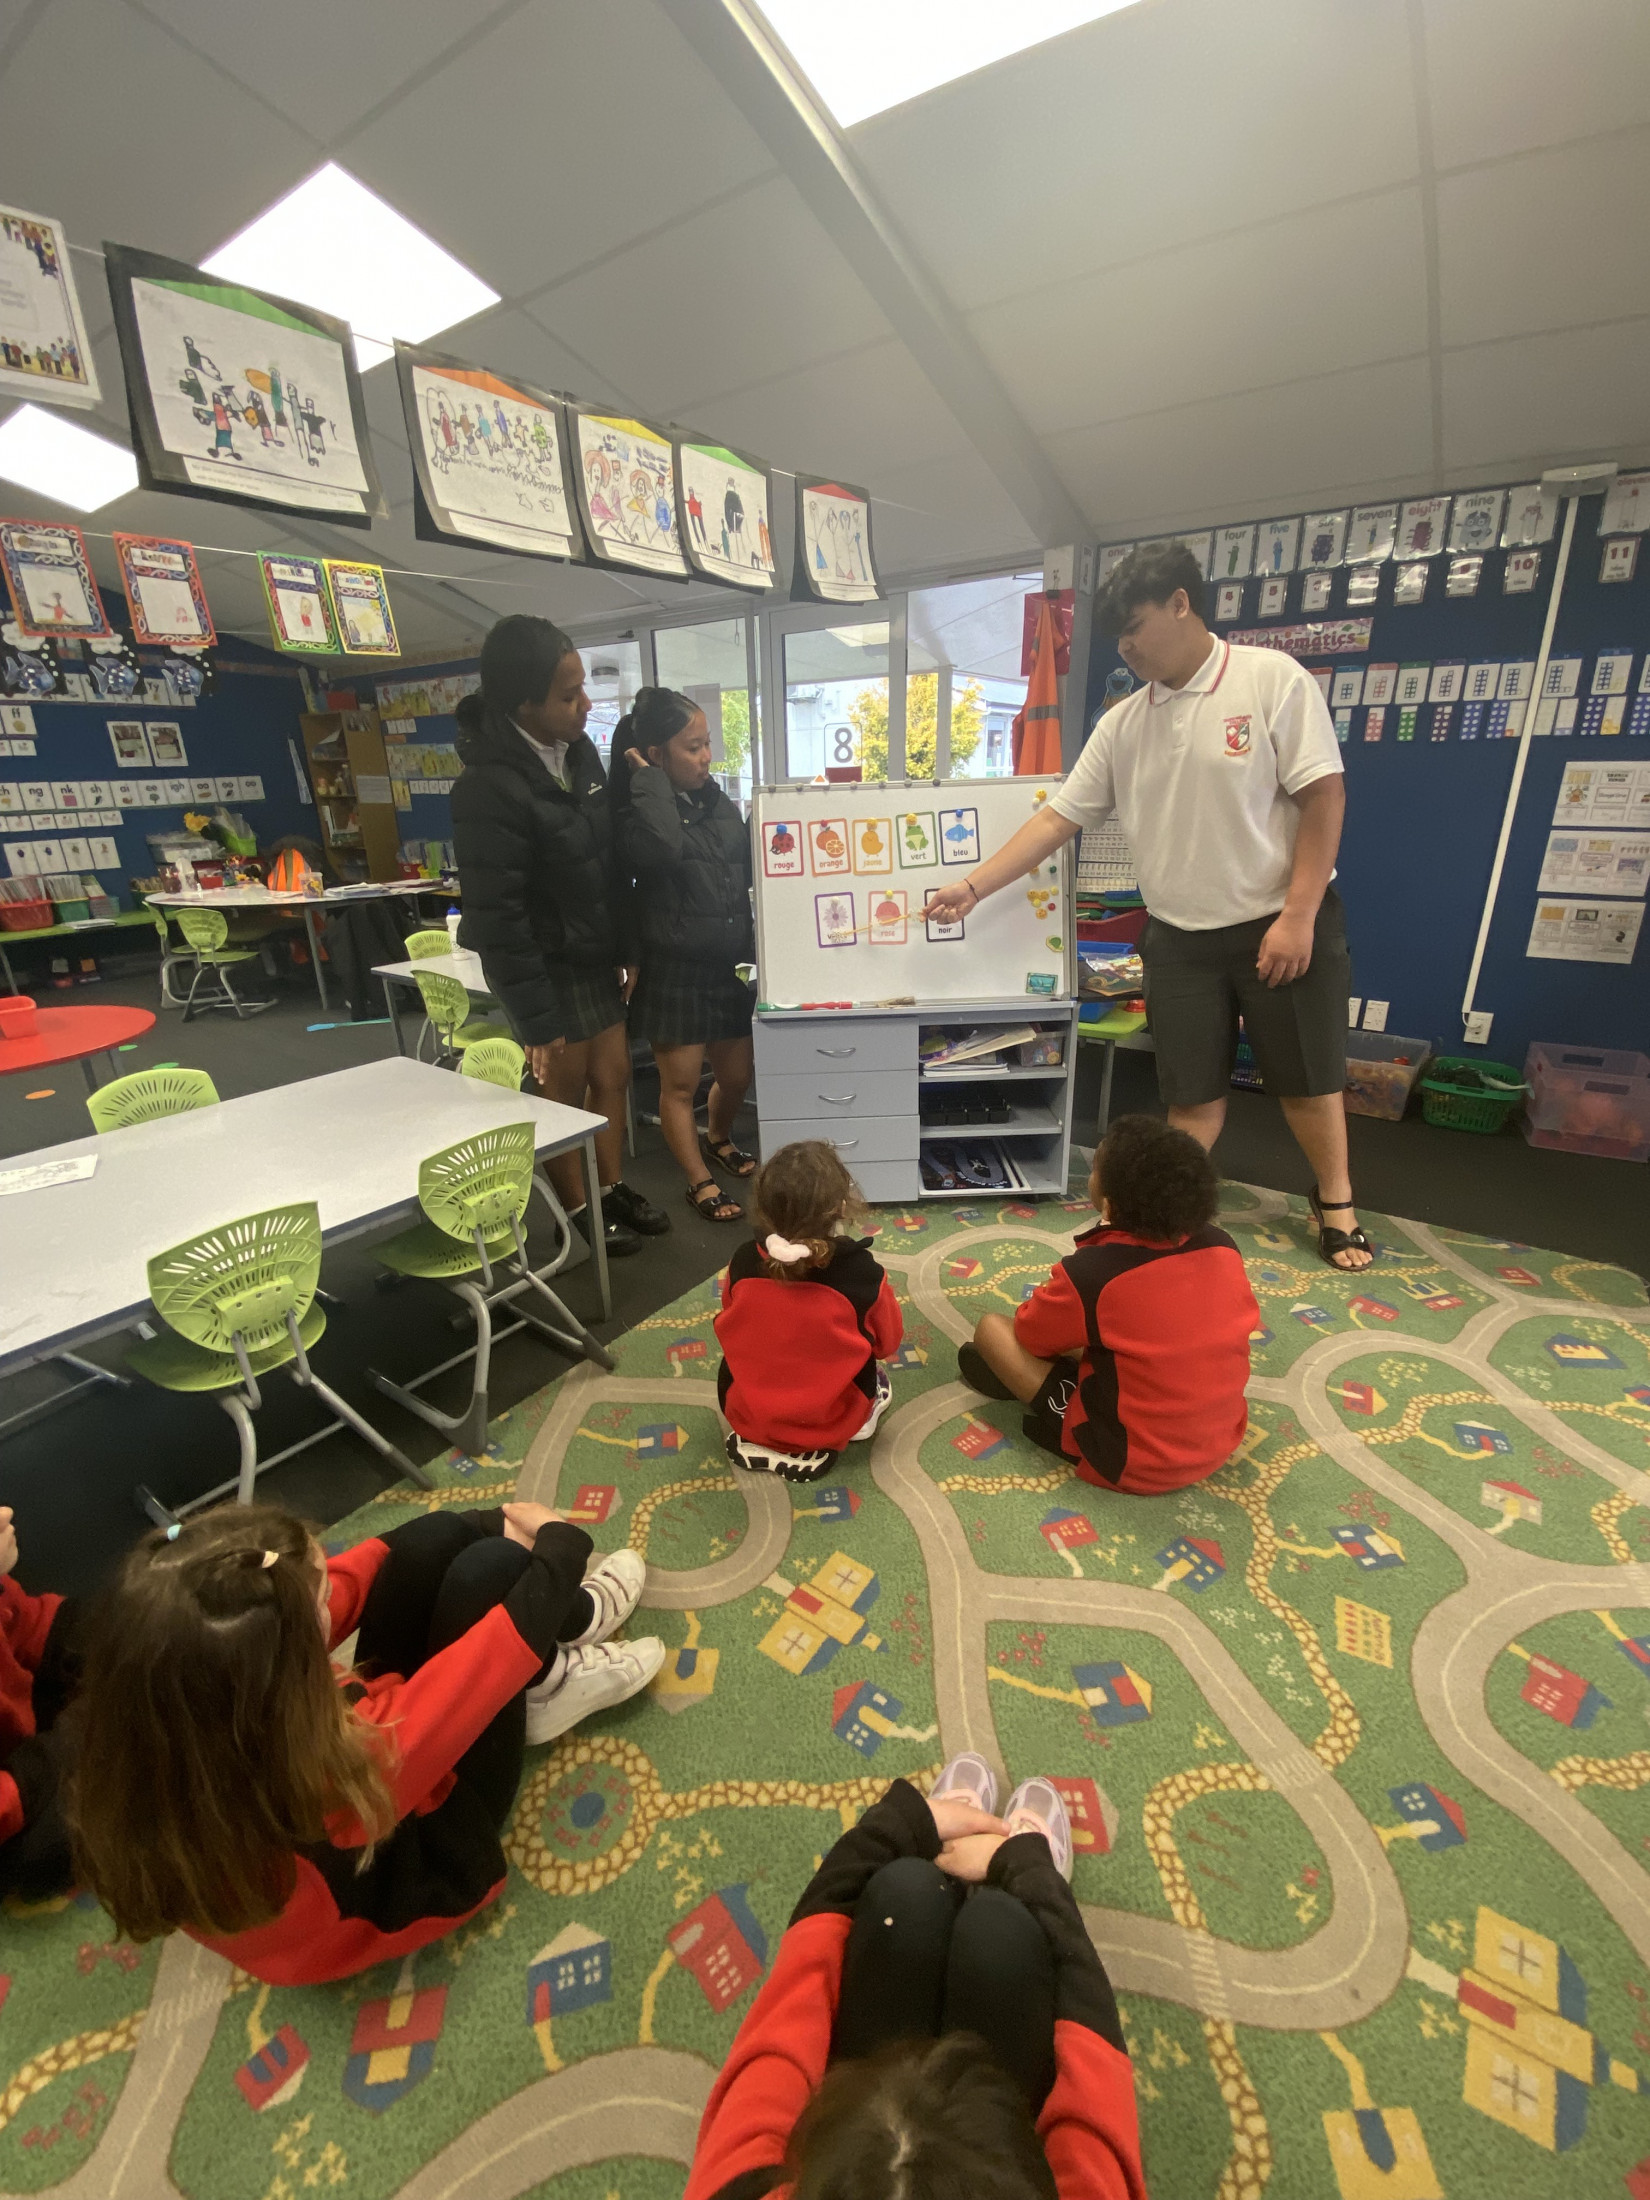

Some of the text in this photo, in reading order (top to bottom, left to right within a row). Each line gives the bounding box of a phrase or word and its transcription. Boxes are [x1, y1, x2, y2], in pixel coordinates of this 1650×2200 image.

[1465, 495, 1495, 507] nine
[1408, 502, 1442, 516] eight
[1357, 508, 1393, 522] seven
[1269, 523, 1290, 535] five
[1224, 529, 1247, 541] four
[1610, 546, 1629, 560] 11
[1514, 558, 1534, 572] 10
[1269, 585, 1278, 596] 5
[833, 727, 854, 764] 8
[28, 787, 44, 797] ng
[60, 784, 74, 794] nk
[90, 783, 103, 793] sh
[119, 785, 131, 793] ai
[910, 852, 927, 861] vert
[953, 849, 969, 857] bleu
[773, 861, 795, 871] rouge
[819, 859, 844, 869] orange
[938, 926, 953, 934] noir
